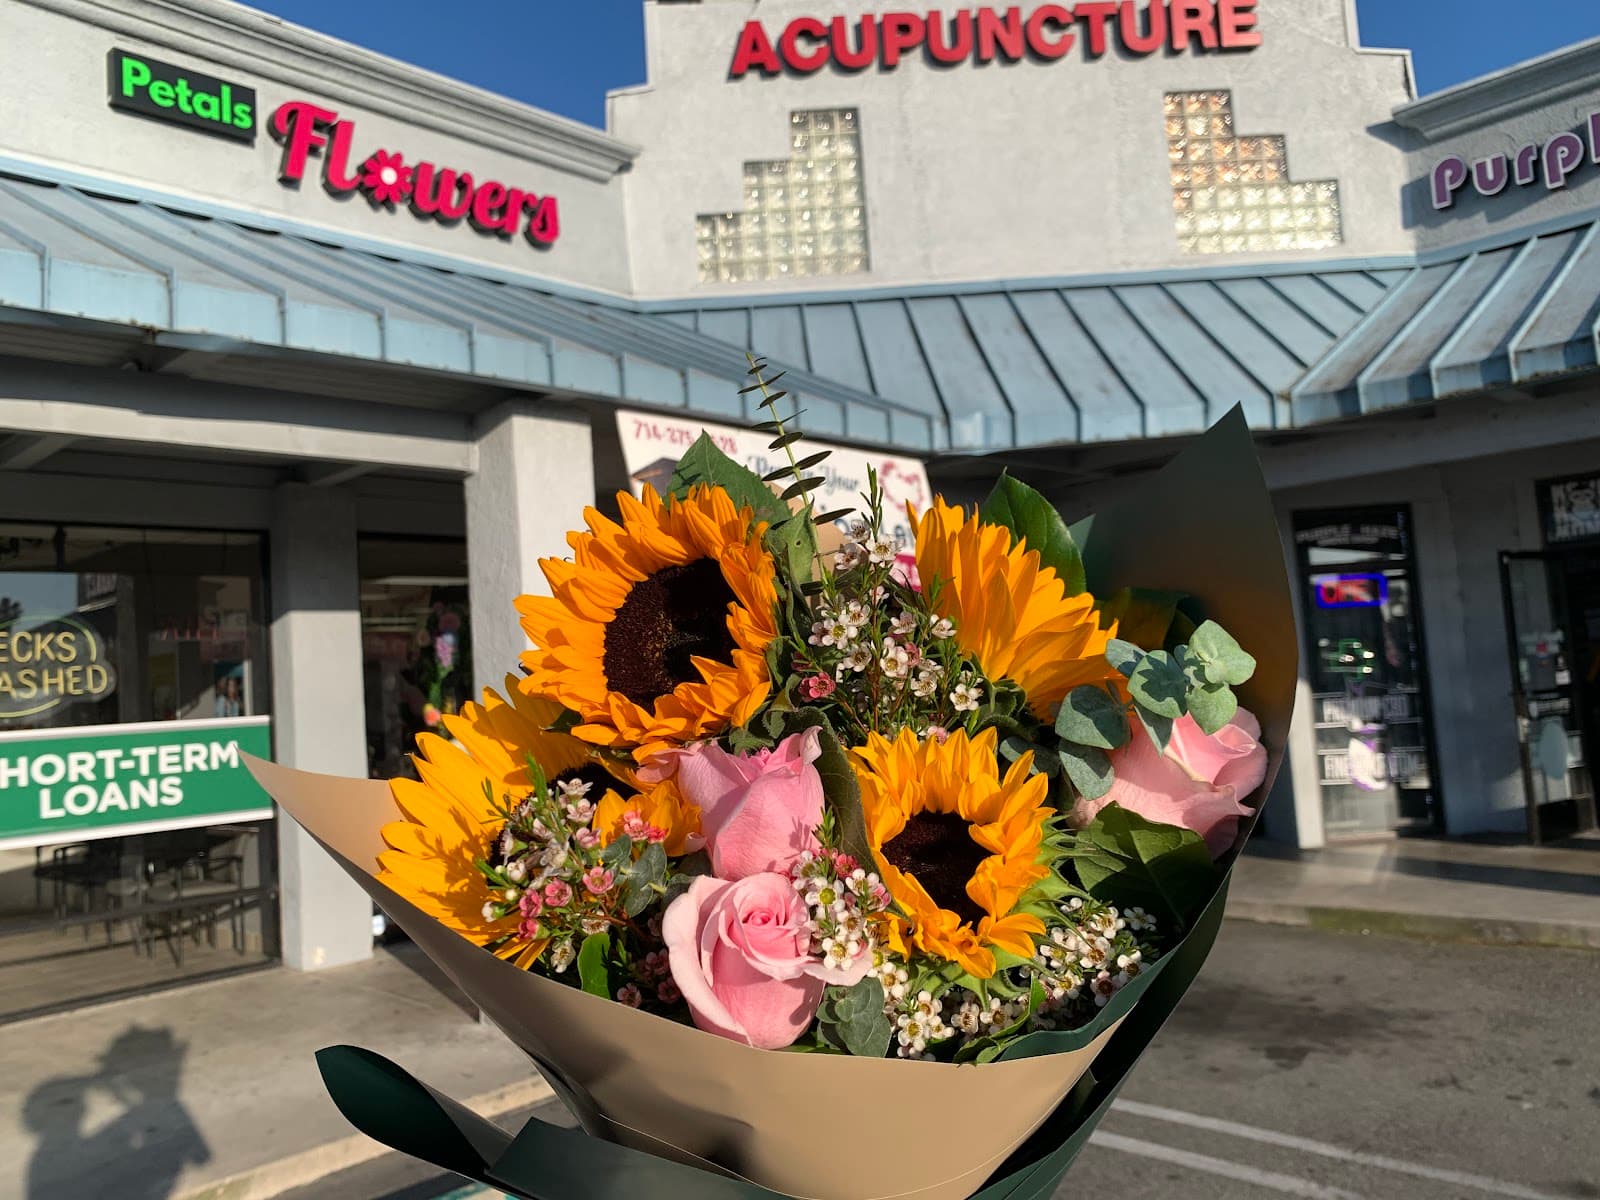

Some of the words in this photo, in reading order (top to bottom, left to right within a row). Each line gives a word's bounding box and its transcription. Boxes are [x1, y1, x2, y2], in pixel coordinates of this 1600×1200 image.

[730, 0, 1262, 75] ACUPUNCTURE
[121, 57, 253, 130] Petals
[272, 101, 560, 245] Flowers
[0, 740, 239, 789] HORT-TERM
[39, 776, 184, 820] LOANS
